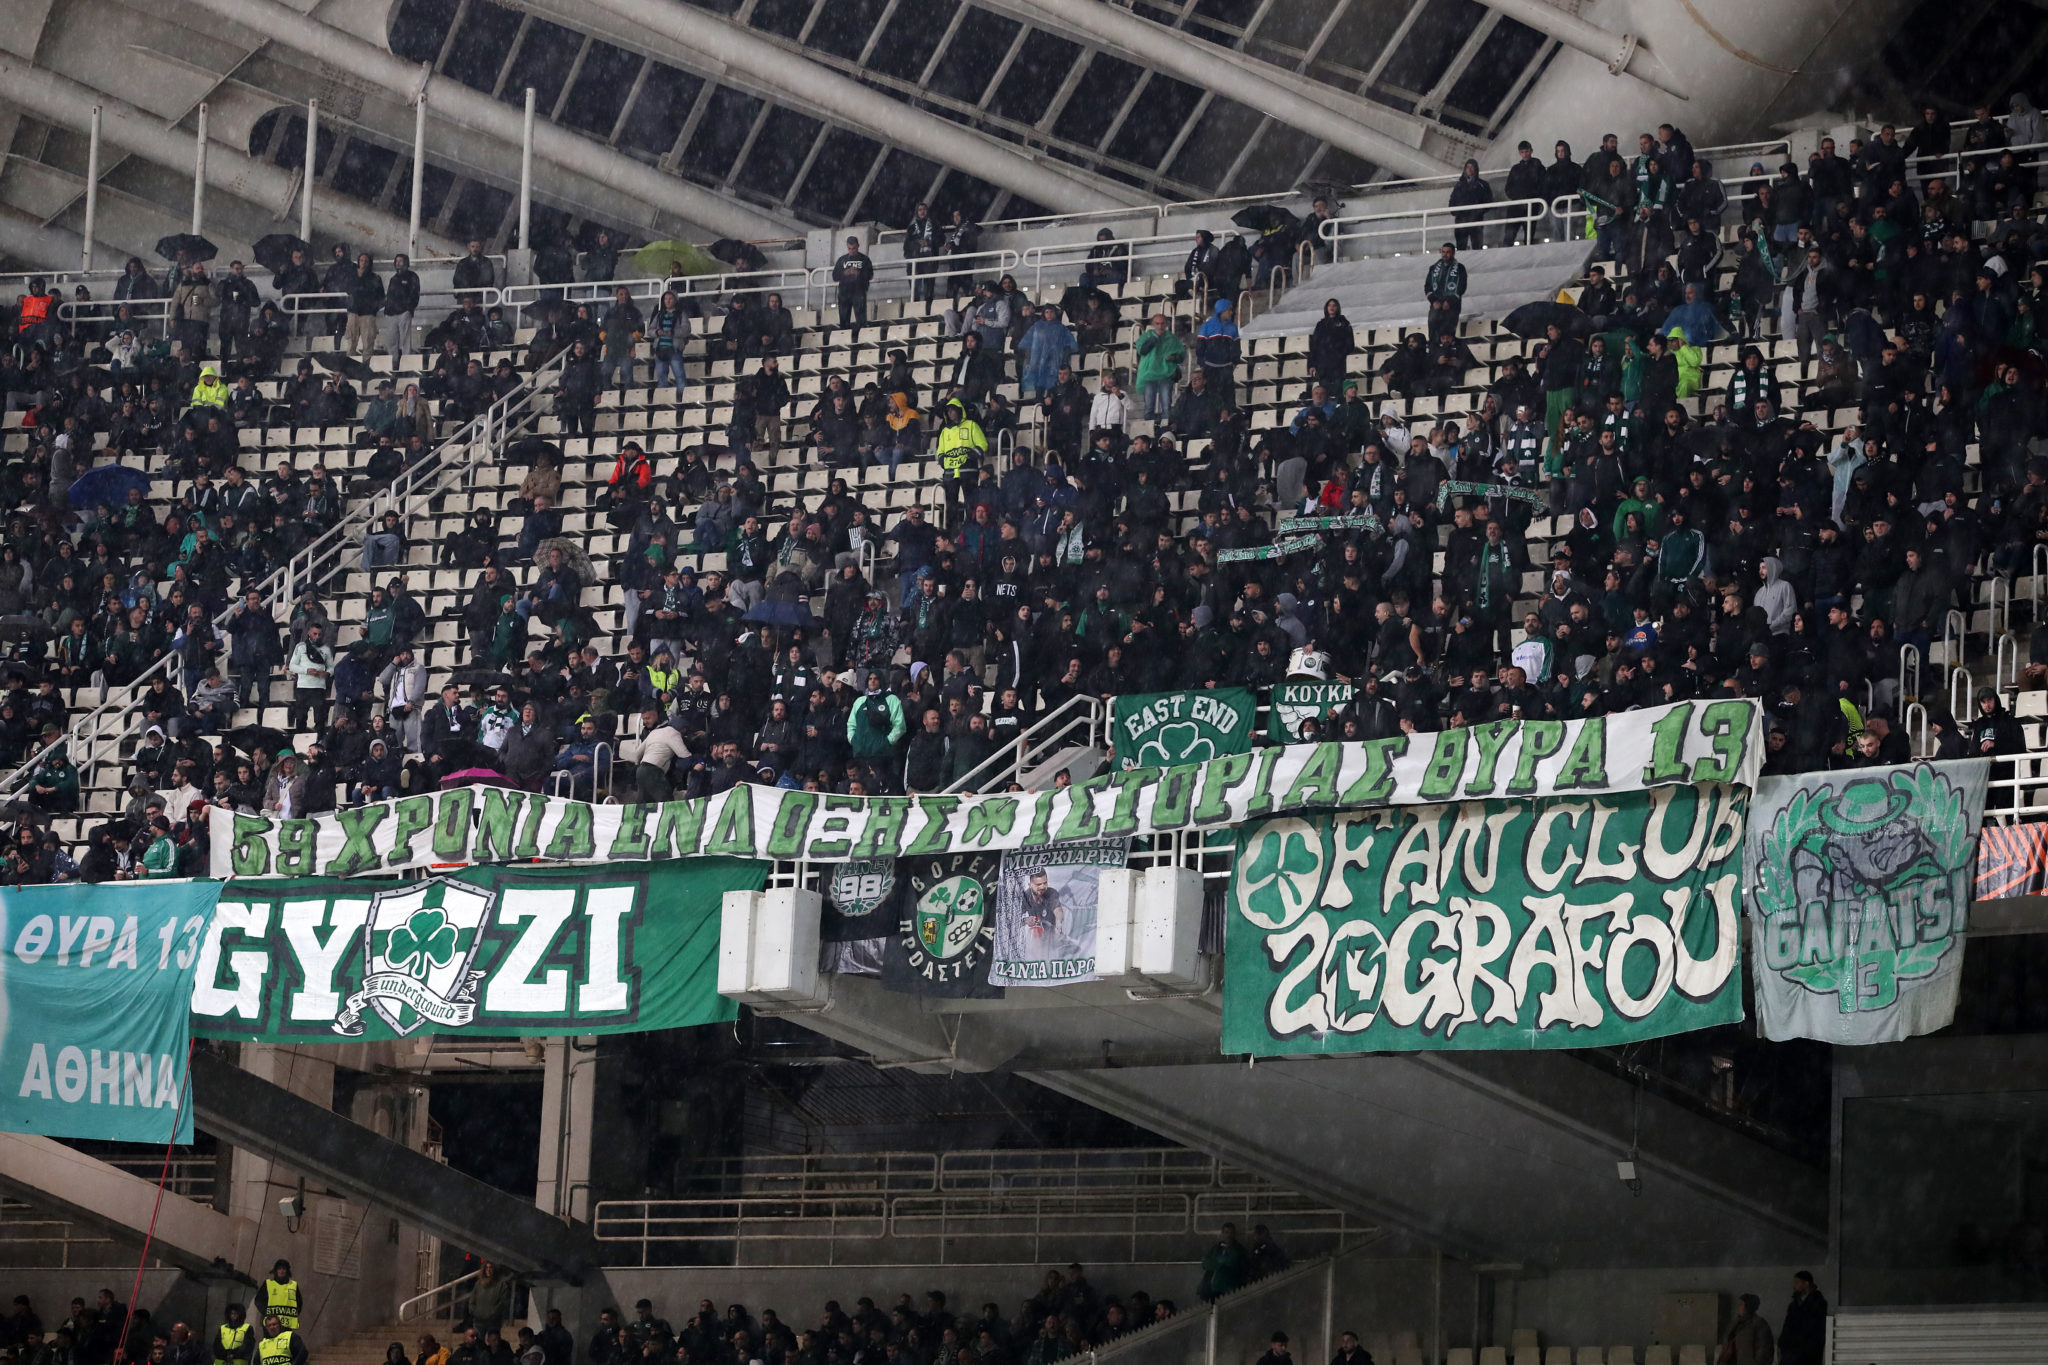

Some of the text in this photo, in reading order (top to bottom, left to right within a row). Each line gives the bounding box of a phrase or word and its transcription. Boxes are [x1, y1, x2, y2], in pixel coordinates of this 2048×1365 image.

[996, 583, 1018, 598] NETS
[1284, 684, 1360, 703] ΚΟΥΚΑ
[1124, 694, 1240, 741] EAST END
[230, 700, 1760, 877] 59 ΧΡΟΝΙΑ ΕΝΔΟΞΗΣ ΙΣΤΟΡΙΑΣ ΘΥΡΑ 13
[911, 854, 1000, 896] ΒΟΡΕΙΑ
[1005, 849, 1125, 871] ΜΠΕΚΙΑΡΗΣ
[1320, 803, 1503, 914] FAN
[838, 873, 885, 903] 98
[13, 913, 205, 971] ΘΥΡΑ 13
[1765, 866, 1971, 971] GALATSI
[899, 919, 996, 983] ΠΡΟΑΣΤΕΙΑ
[995, 960, 1048, 980] ΠΑΝΤΑ
[379, 977, 456, 1020] underground
[1838, 950, 1899, 1014] 13
[18, 1042, 180, 1110] ΑΘΗΝΑ
